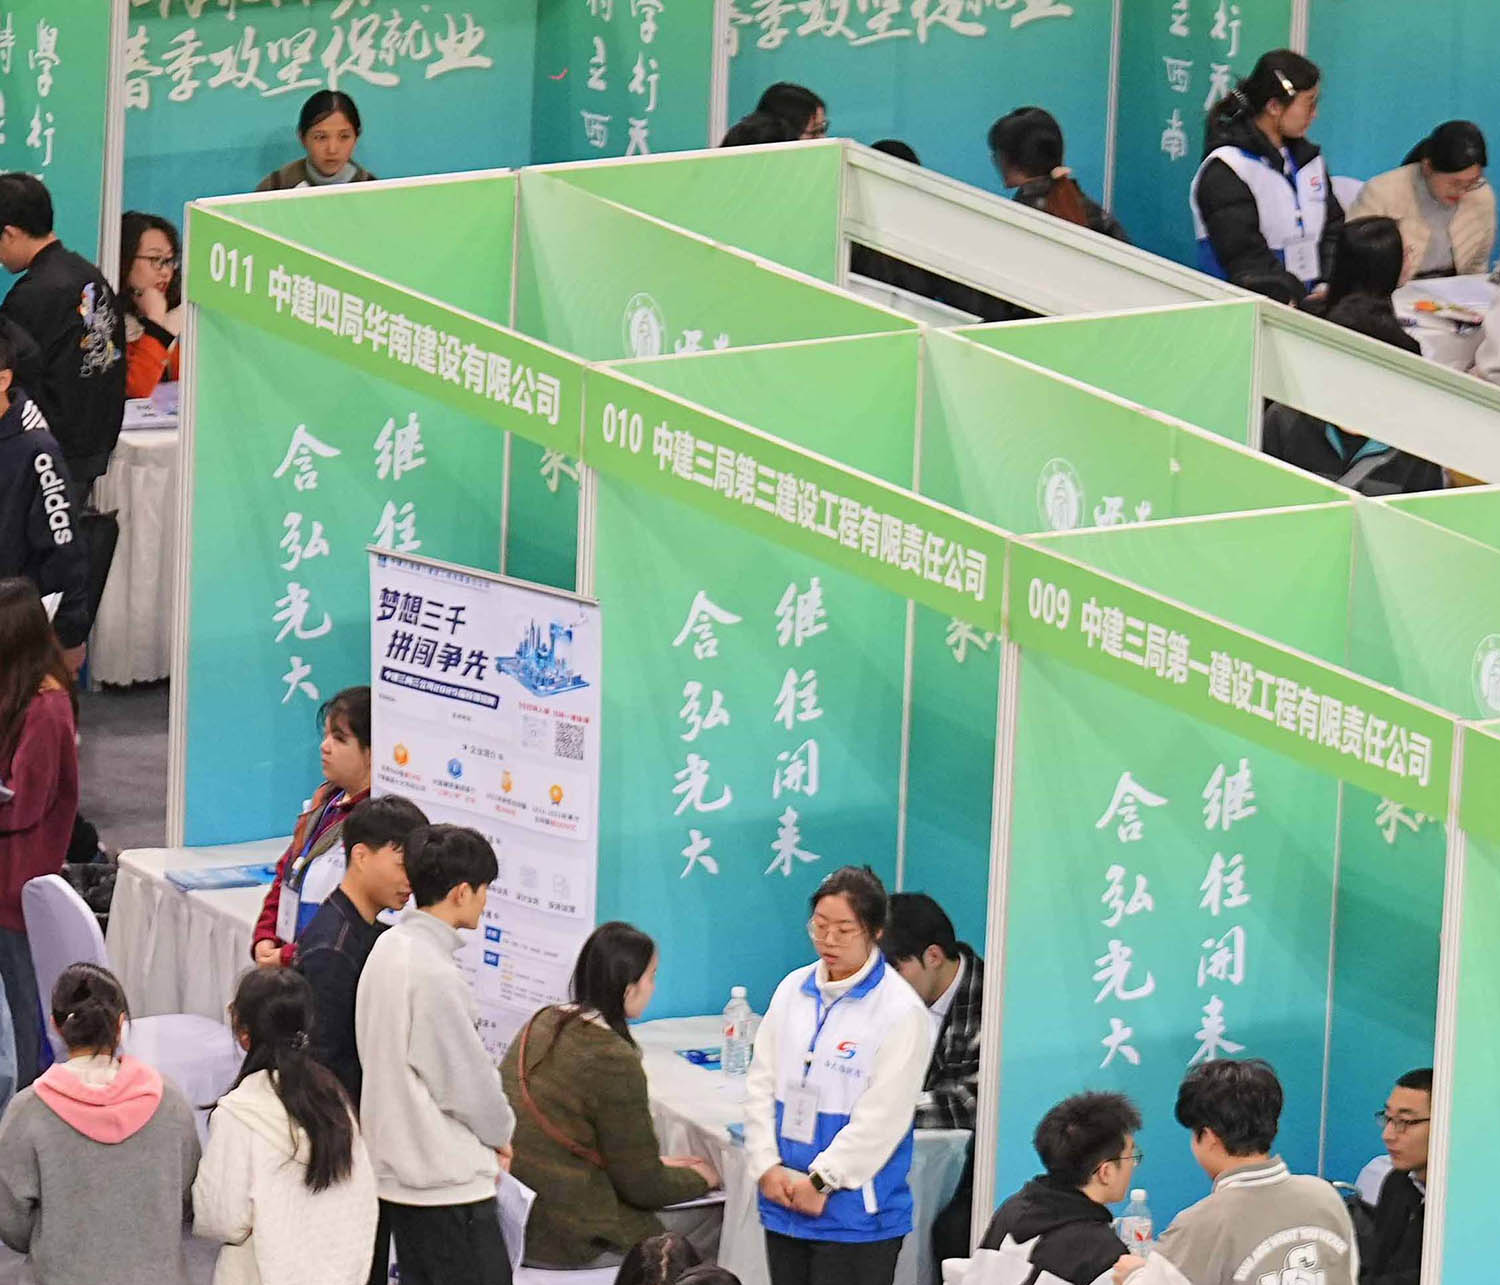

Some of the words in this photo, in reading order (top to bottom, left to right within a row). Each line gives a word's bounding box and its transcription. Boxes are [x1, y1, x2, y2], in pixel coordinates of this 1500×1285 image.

[208, 242, 255, 296] 011
[268, 264, 562, 423] 中建四局华南建设有限公司
[34, 452, 73, 546] adidas
[271, 424, 340, 704] 含弘光大
[601, 403, 645, 454] 010
[652, 425, 988, 603] 中建三局第三建设工程有限责任公司
[376, 587, 467, 635] 梦想三千
[385, 630, 489, 681] 拼闯争先
[1027, 576, 1071, 630] 009
[1080, 597, 1431, 788] 中建三局第一建设工程有限责任公司
[670, 590, 742, 877] 含弘光大
[1094, 770, 1169, 1069] 含弘光大
